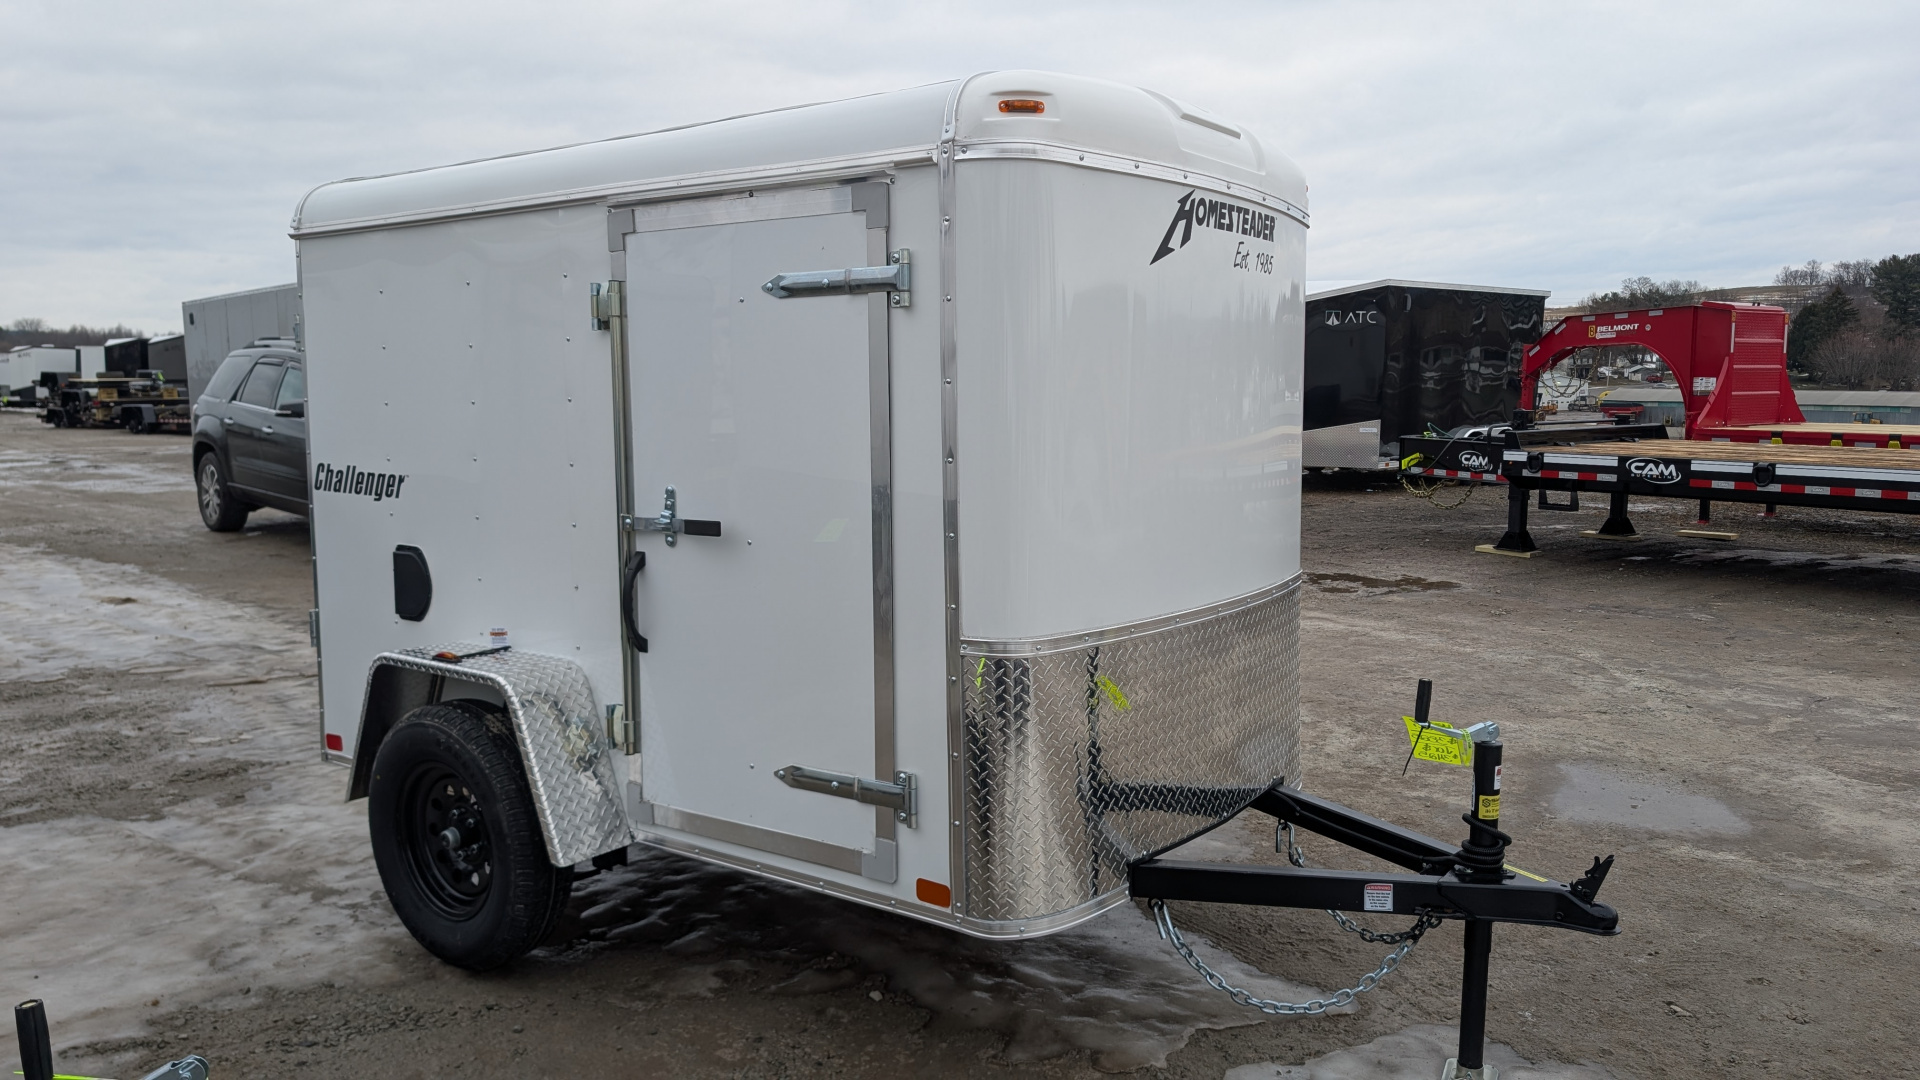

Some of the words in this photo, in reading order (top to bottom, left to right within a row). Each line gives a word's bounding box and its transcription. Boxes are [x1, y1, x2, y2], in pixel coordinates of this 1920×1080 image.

[1150, 189, 1276, 265] HOMESTEADER
[1234, 241, 1250, 272] Est.
[1256, 252, 1274, 275] 1985
[1345, 311, 1377, 323] ATC
[1597, 323, 1639, 332] BELMONT
[1462, 454, 1488, 465] CAM
[1630, 462, 1677, 477] CAM
[314, 462, 405, 501] Challenger
